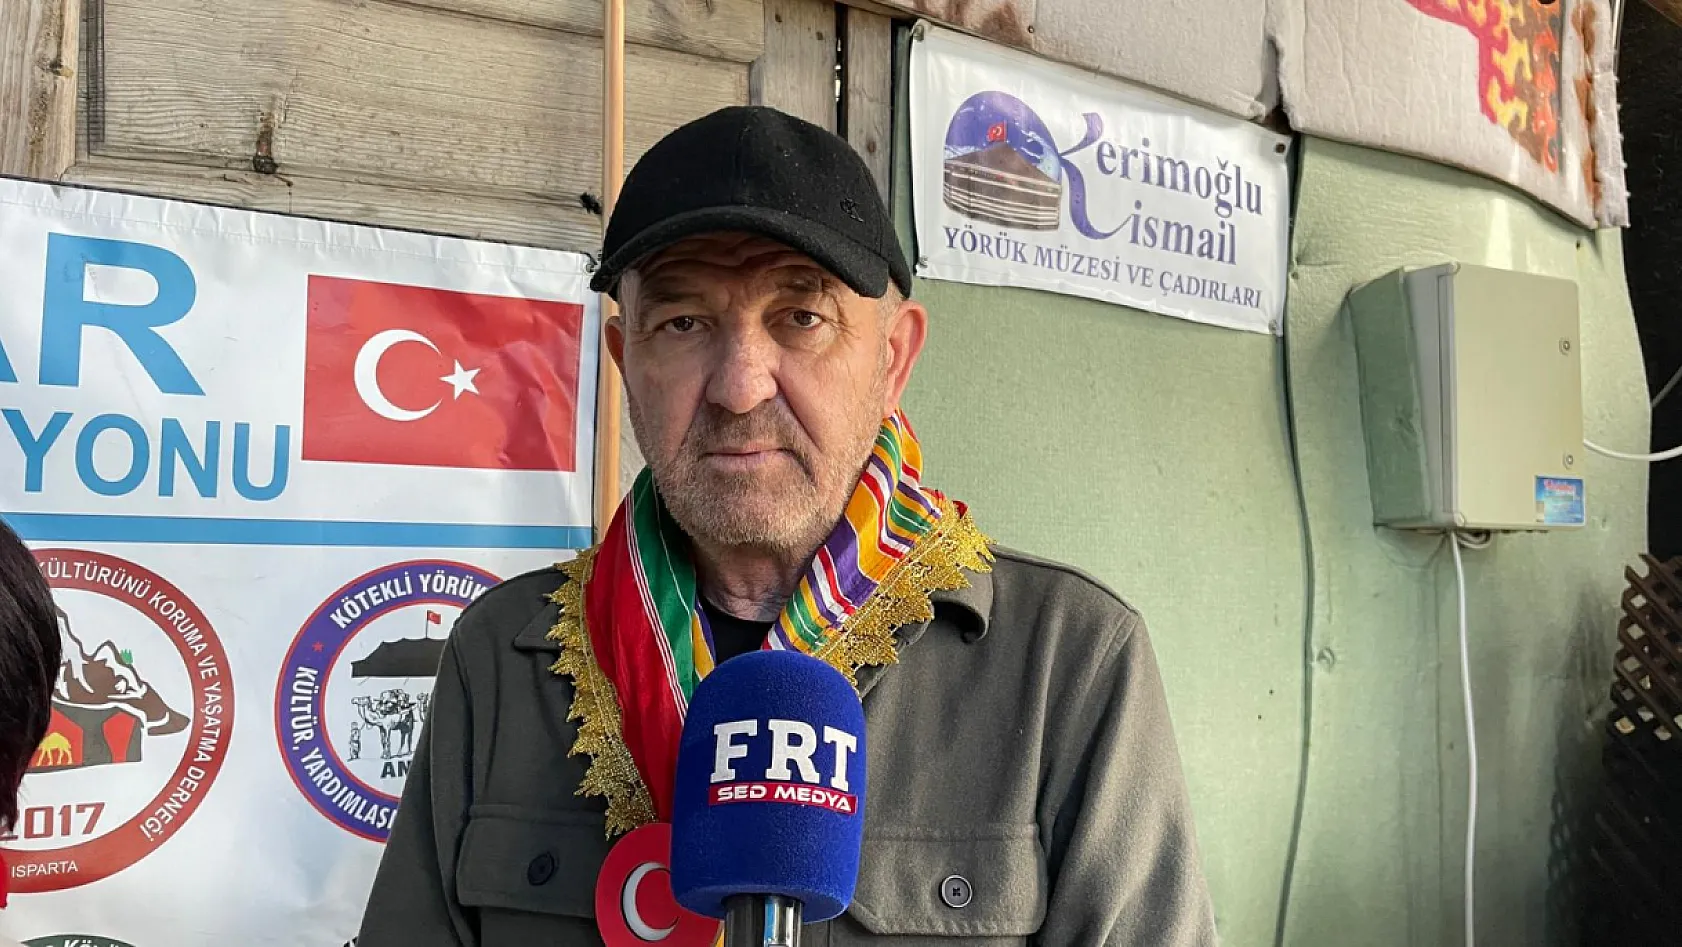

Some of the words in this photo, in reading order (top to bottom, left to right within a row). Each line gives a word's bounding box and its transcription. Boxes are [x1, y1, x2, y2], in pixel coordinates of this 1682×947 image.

[942, 223, 1029, 264] YÖRÜK
[1033, 244, 1121, 283] MÜZESİ
[1126, 263, 1154, 288] VE
[1159, 271, 1263, 309] ÇADIRLARI
[0, 232, 207, 397] R
[0, 408, 291, 502] YONU
[147, 591, 209, 656] KORUMA
[329, 570, 413, 629] KÖTEKLİ
[198, 654, 219, 680] VE
[193, 681, 224, 762] YAŞATMA
[290, 666, 320, 751] KÜLTÜR,
[710, 718, 858, 792] FRT
[0, 801, 106, 840] 017
[139, 766, 206, 843] DERNEĞİ
[716, 784, 768, 802] SED
[773, 785, 852, 813] MEDYA
[11, 860, 79, 879] ISPARTA
